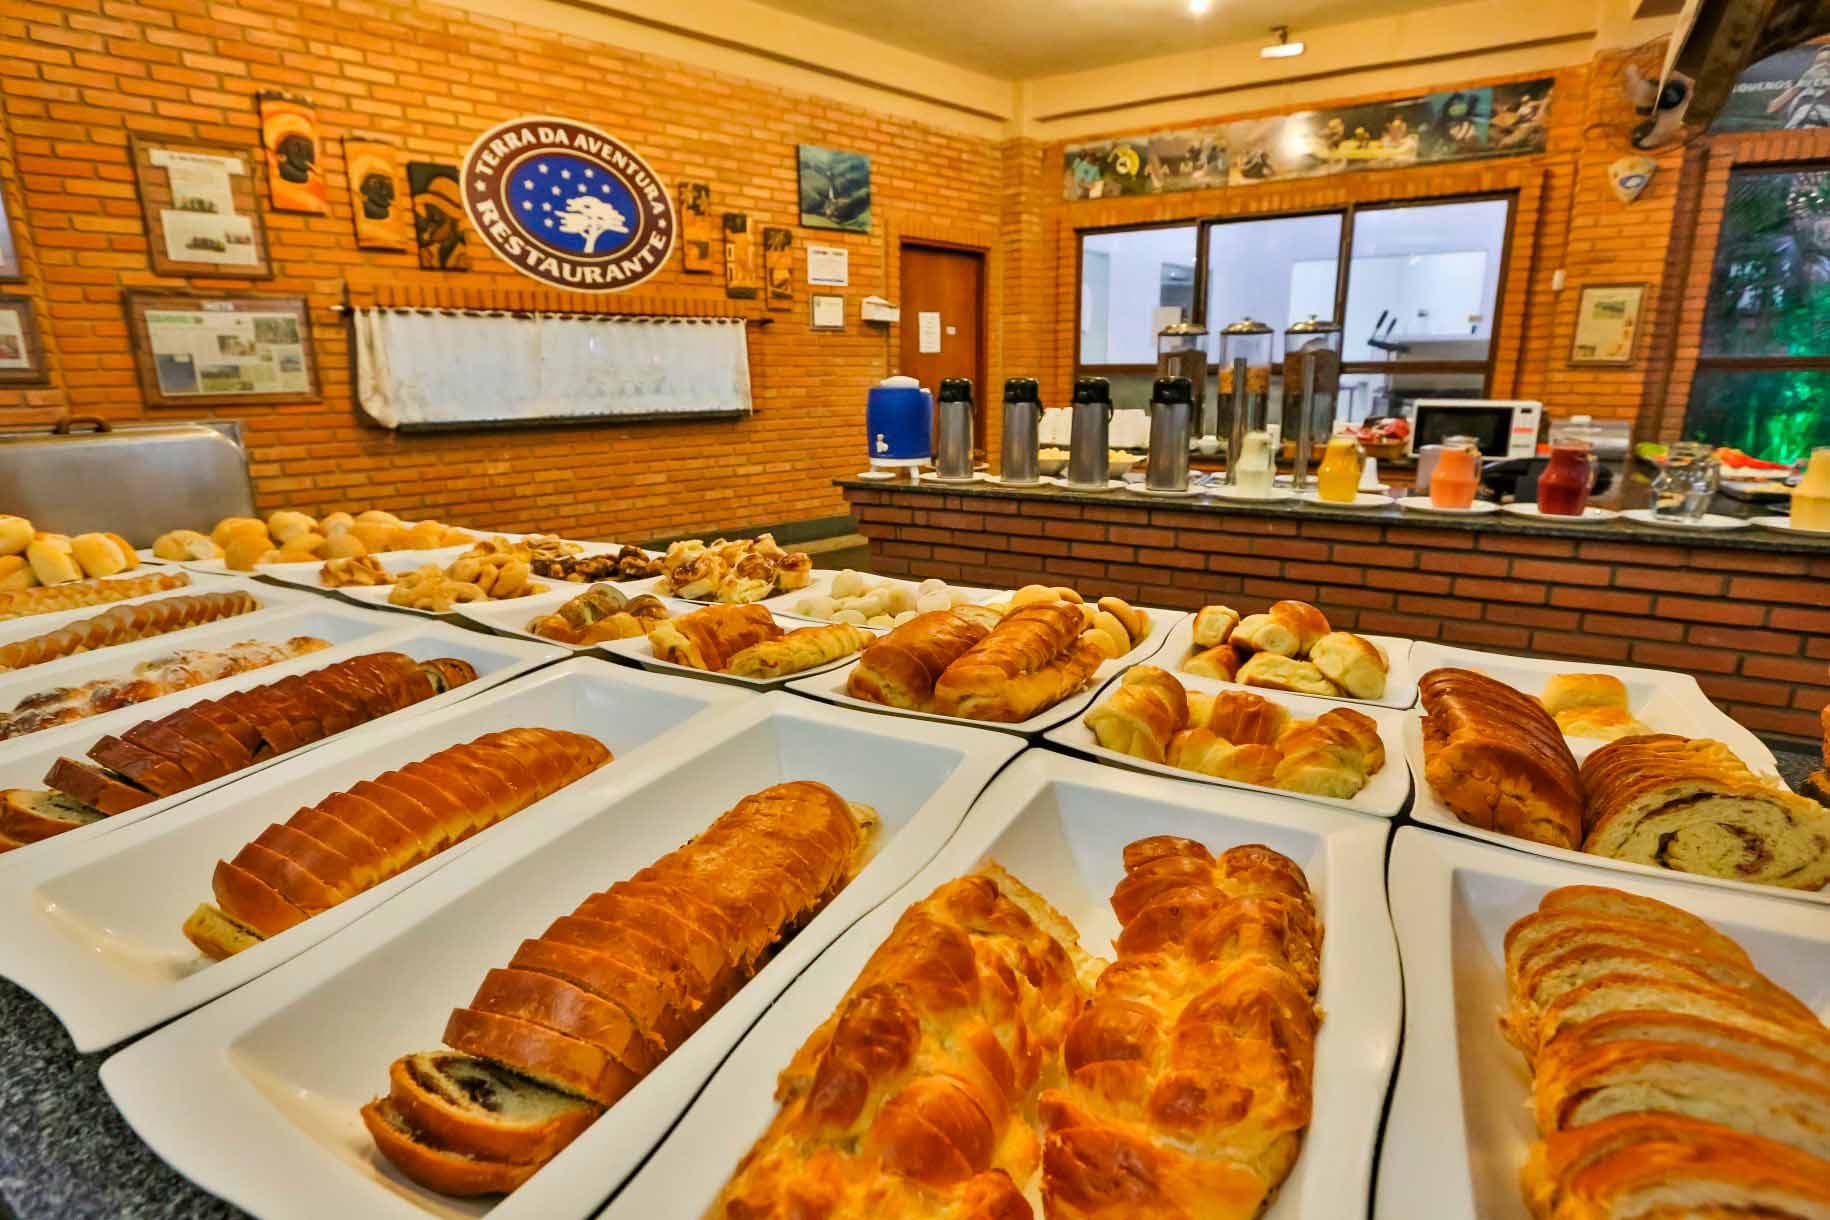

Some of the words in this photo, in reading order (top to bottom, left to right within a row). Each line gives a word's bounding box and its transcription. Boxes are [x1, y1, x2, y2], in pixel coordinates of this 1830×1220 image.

[475, 127, 536, 176] TERRA
[537, 127, 570, 146] DA
[573, 133, 666, 215] AVENTURA
[476, 198, 666, 284] RESTAURANTE
